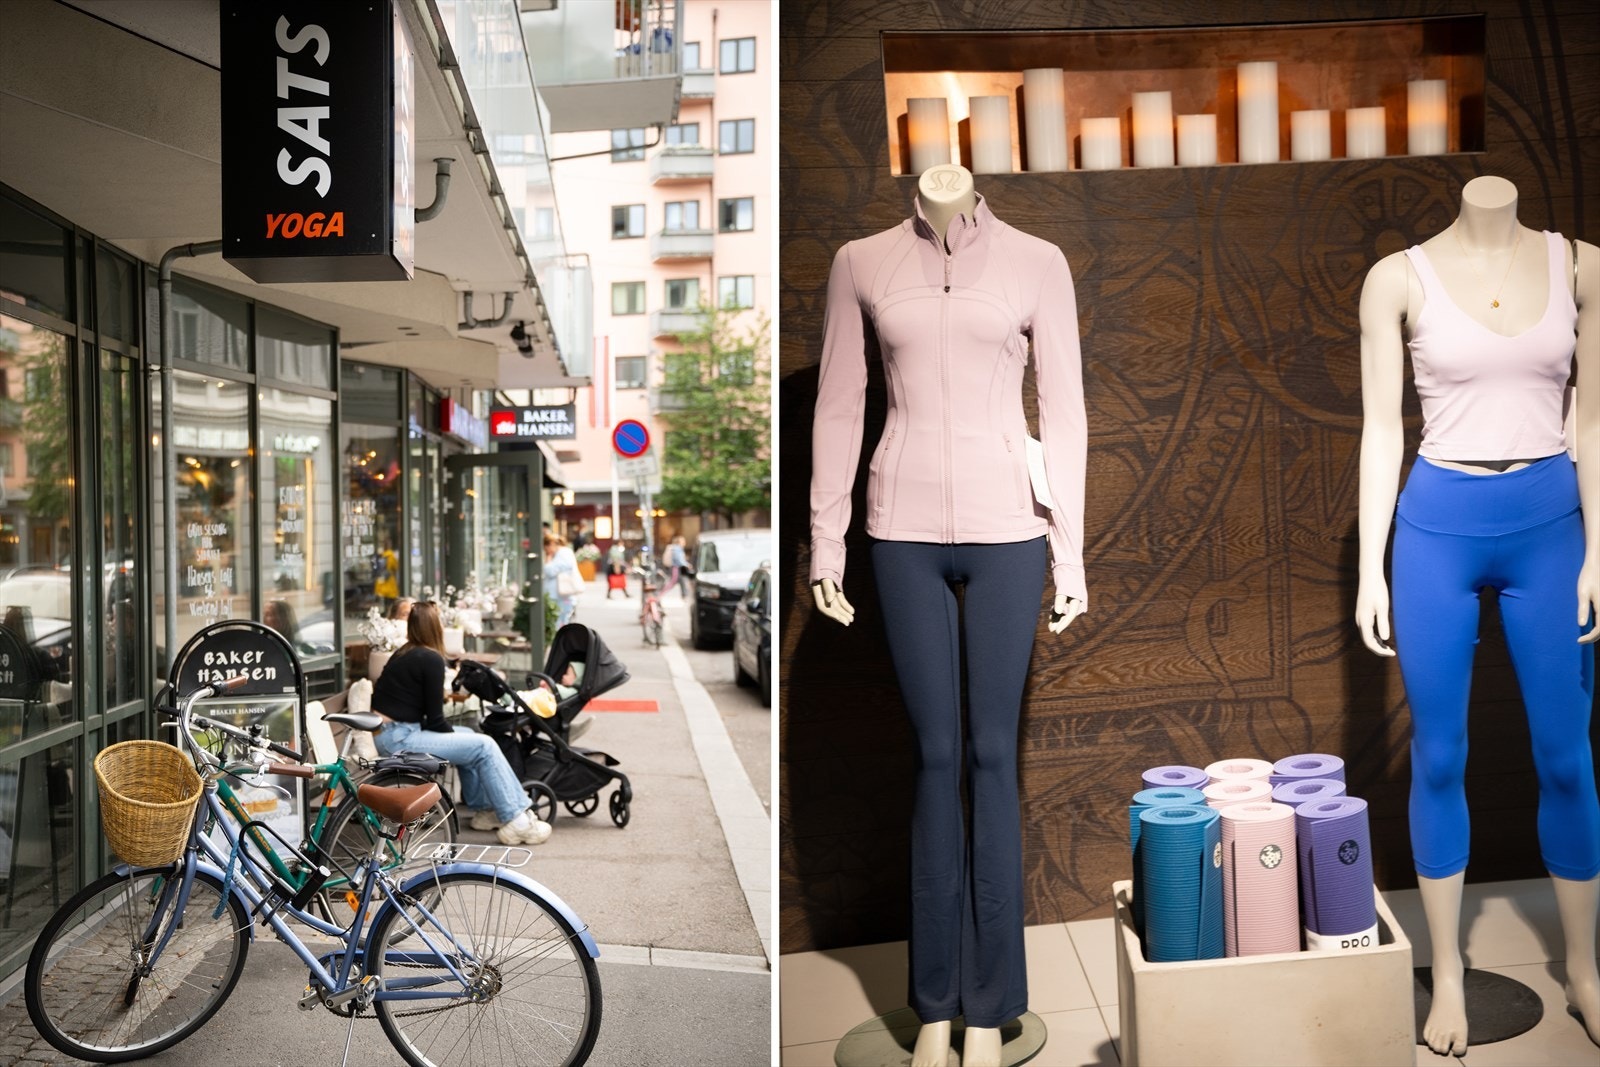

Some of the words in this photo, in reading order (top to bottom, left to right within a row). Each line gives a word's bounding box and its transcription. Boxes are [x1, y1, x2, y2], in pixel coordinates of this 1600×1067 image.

[275, 14, 332, 198] SATS
[265, 211, 345, 239] YOGA
[523, 409, 568, 422] BAKER
[517, 422, 575, 436] HANSEN
[204, 650, 264, 666] Baker
[197, 666, 277, 682] Hansen
[239, 706, 266, 714] HANSEN
[1341, 935, 1370, 949] PRO
